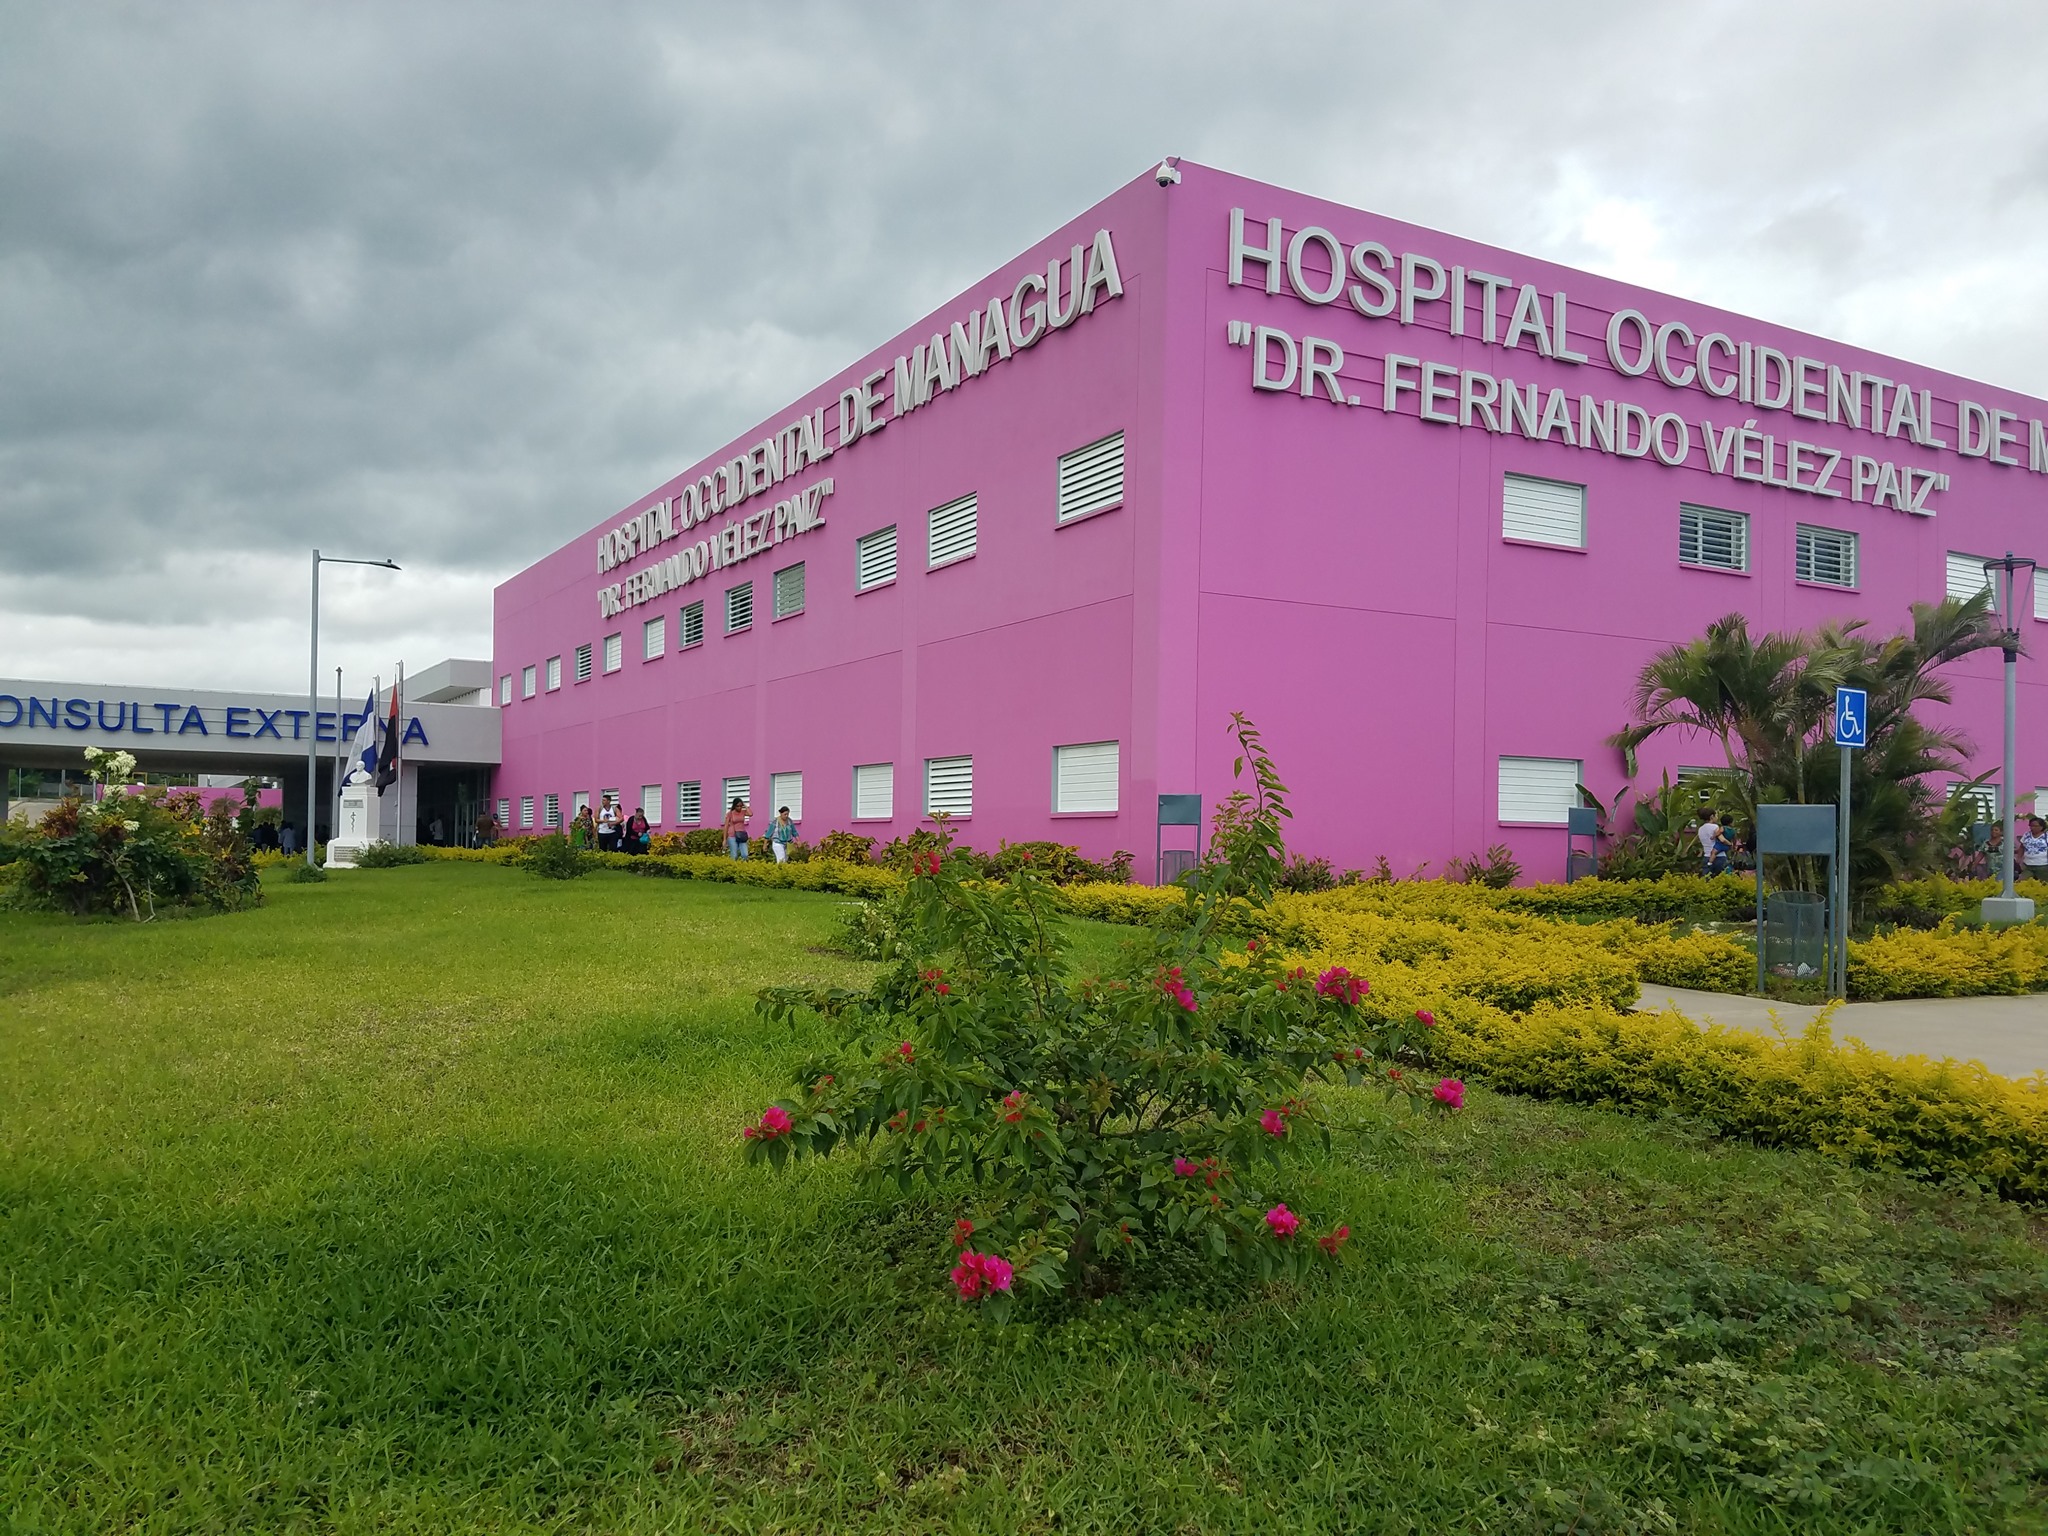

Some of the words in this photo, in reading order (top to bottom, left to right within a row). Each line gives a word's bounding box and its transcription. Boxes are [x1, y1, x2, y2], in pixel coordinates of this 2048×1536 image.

[597, 497, 679, 574] HOSPITAL
[680, 407, 834, 530] OCCIDENTAL
[839, 369, 886, 448] DE
[894, 228, 1124, 416] MANAGUA
[1227, 320, 1361, 406] "DR.
[1383, 353, 1690, 466] FERNANDO
[1700, 419, 1842, 498] VÉLEZ
[1851, 454, 1950, 518] PAIZ"
[1228, 207, 1589, 365] HOSPITAL
[1606, 308, 1947, 449] OCCIDENTAL
[1958, 400, 2019, 466] DE
[625, 541, 710, 608] FERNANDO
[710, 508, 773, 570] VÉLEZ
[774, 477, 834, 543] PAIZ"
